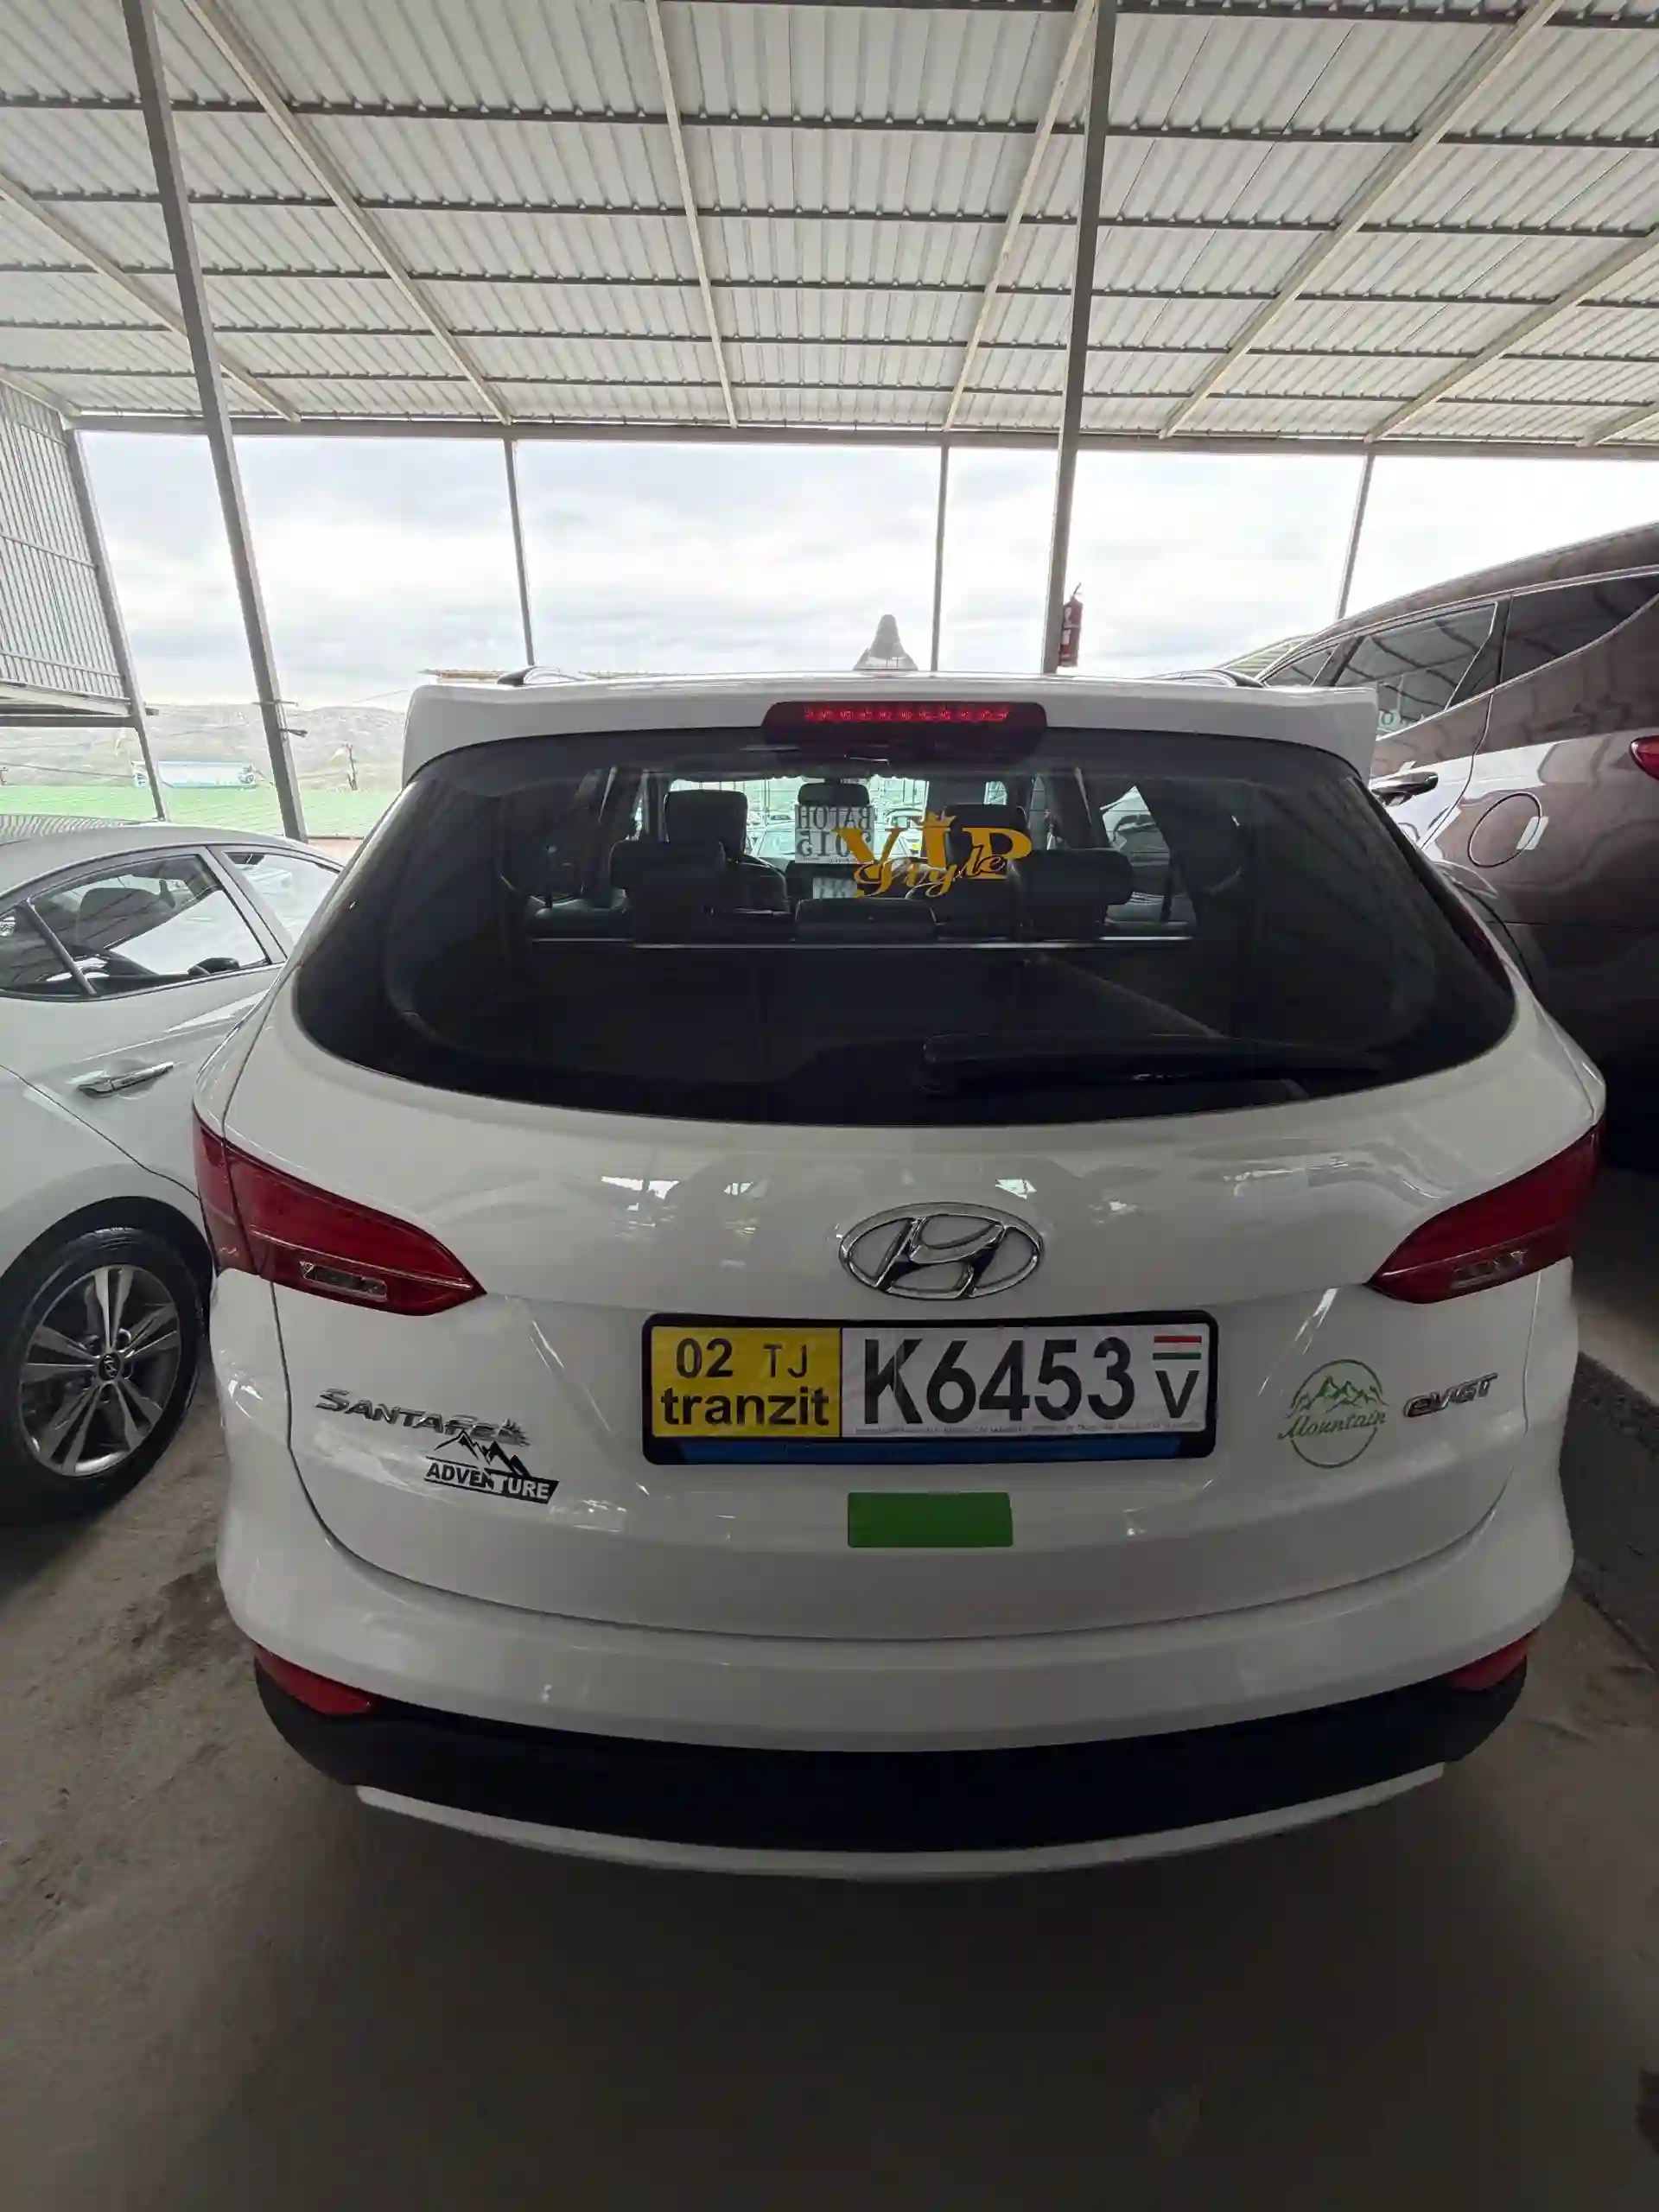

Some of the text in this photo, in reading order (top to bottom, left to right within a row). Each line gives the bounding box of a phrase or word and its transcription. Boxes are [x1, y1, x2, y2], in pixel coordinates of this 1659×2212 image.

[831, 826, 1033, 880] VIP
[677, 1337, 809, 1378] 02 TJ
[864, 1337, 1135, 1425] K6453
[1156, 1370, 1199, 1419] V
[660, 1386, 830, 1426] tranzit
[426, 1461, 550, 1501] ADVENTURE
